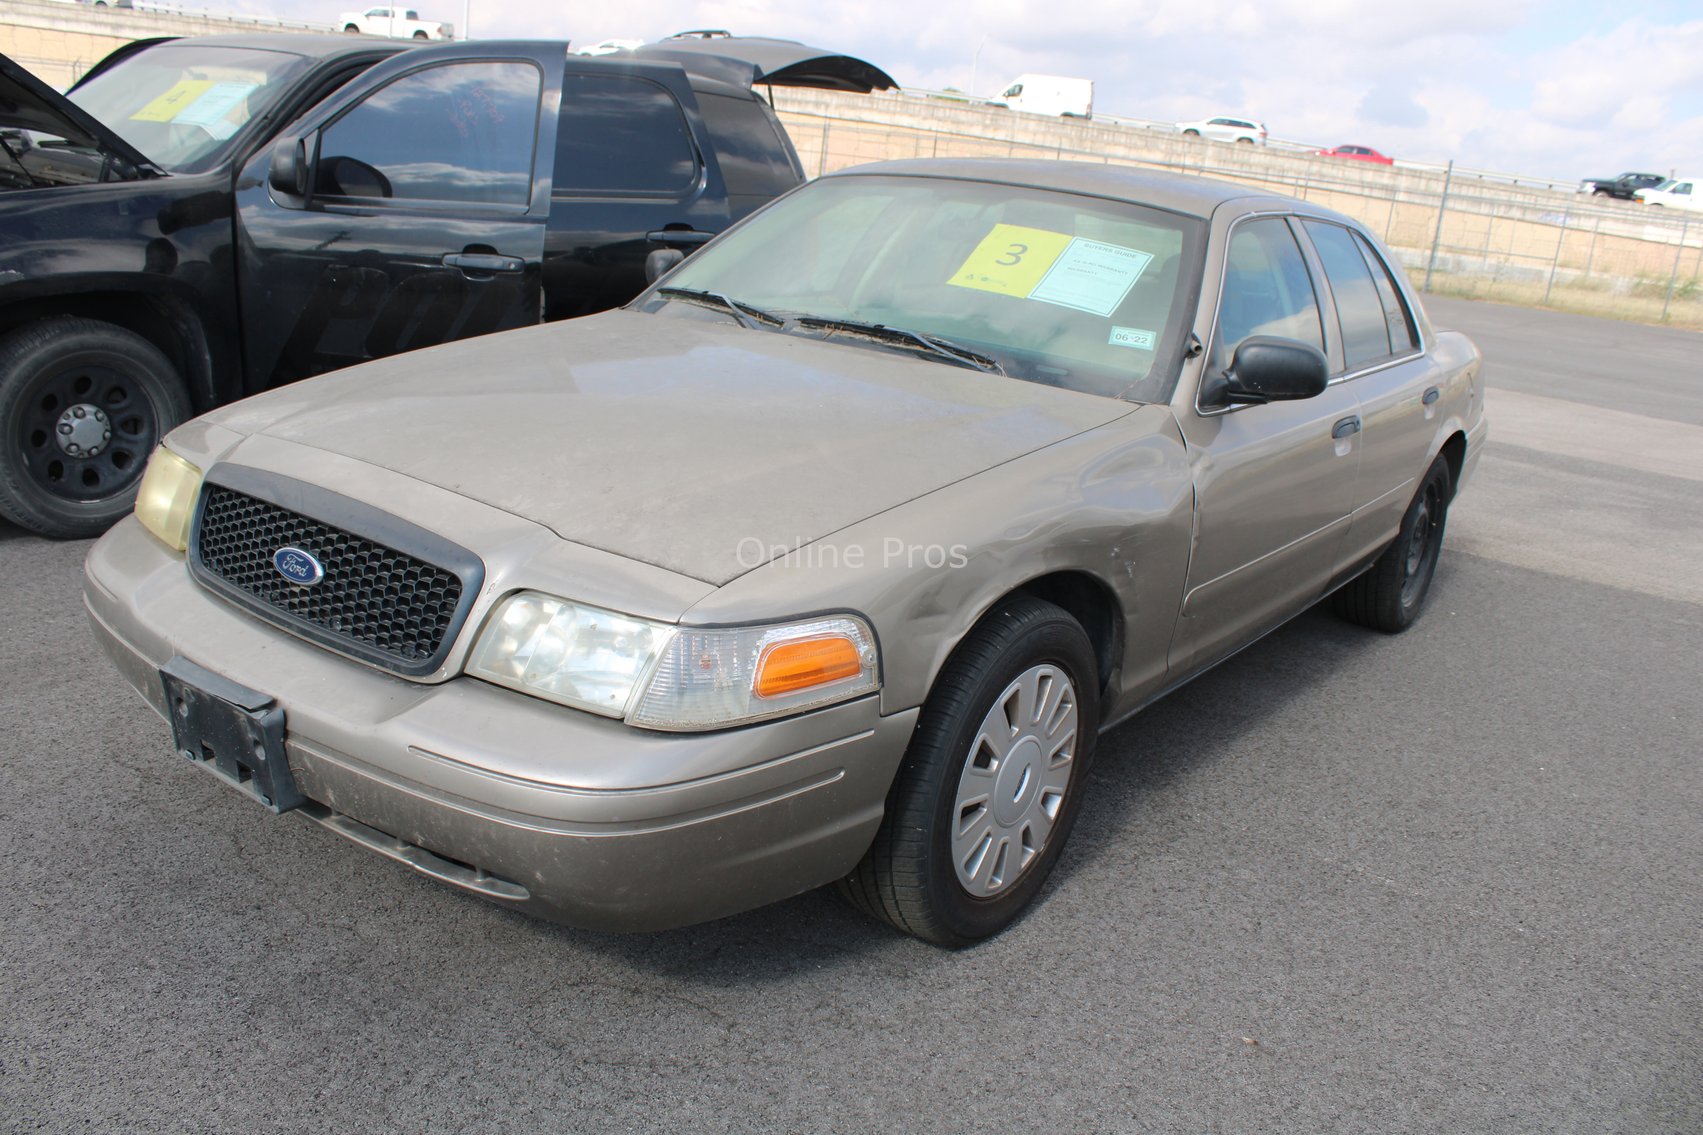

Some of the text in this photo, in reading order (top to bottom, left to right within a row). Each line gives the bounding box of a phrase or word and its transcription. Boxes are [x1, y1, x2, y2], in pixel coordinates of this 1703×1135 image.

[994, 243, 1029, 267] 3
[1113, 248, 1138, 259] GUIDE
[283, 553, 309, 577] Ford
